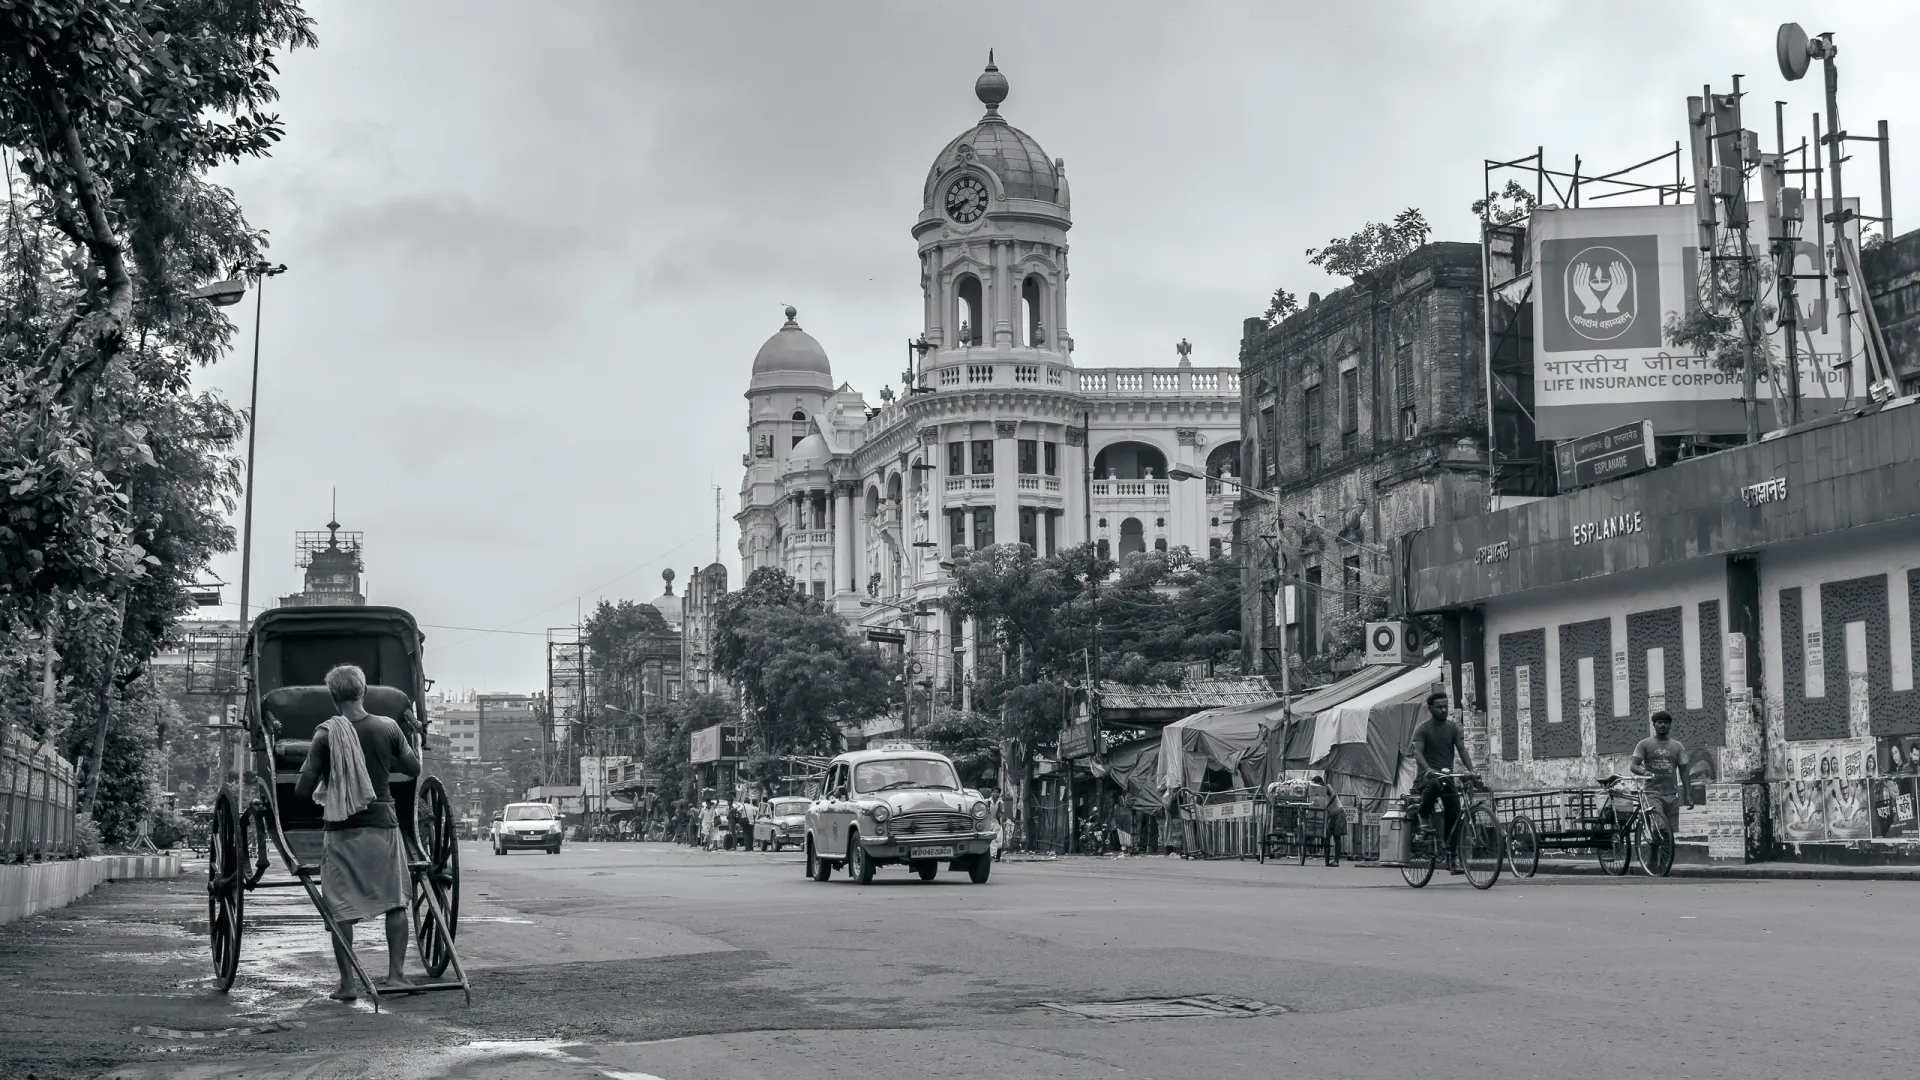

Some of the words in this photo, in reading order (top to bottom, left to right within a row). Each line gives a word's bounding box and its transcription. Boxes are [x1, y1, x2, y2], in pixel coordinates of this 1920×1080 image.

[1543, 354, 1629, 375] भारतीय
[1642, 352, 1708, 371] जीवन
[1544, 379, 1575, 391] LIFE
[1580, 374, 1667, 390] INSURANCE
[1811, 371, 1843, 383] INDI
[1594, 455, 1627, 475] ESPLANADE
[1573, 510, 1643, 546] ESPLANADE
